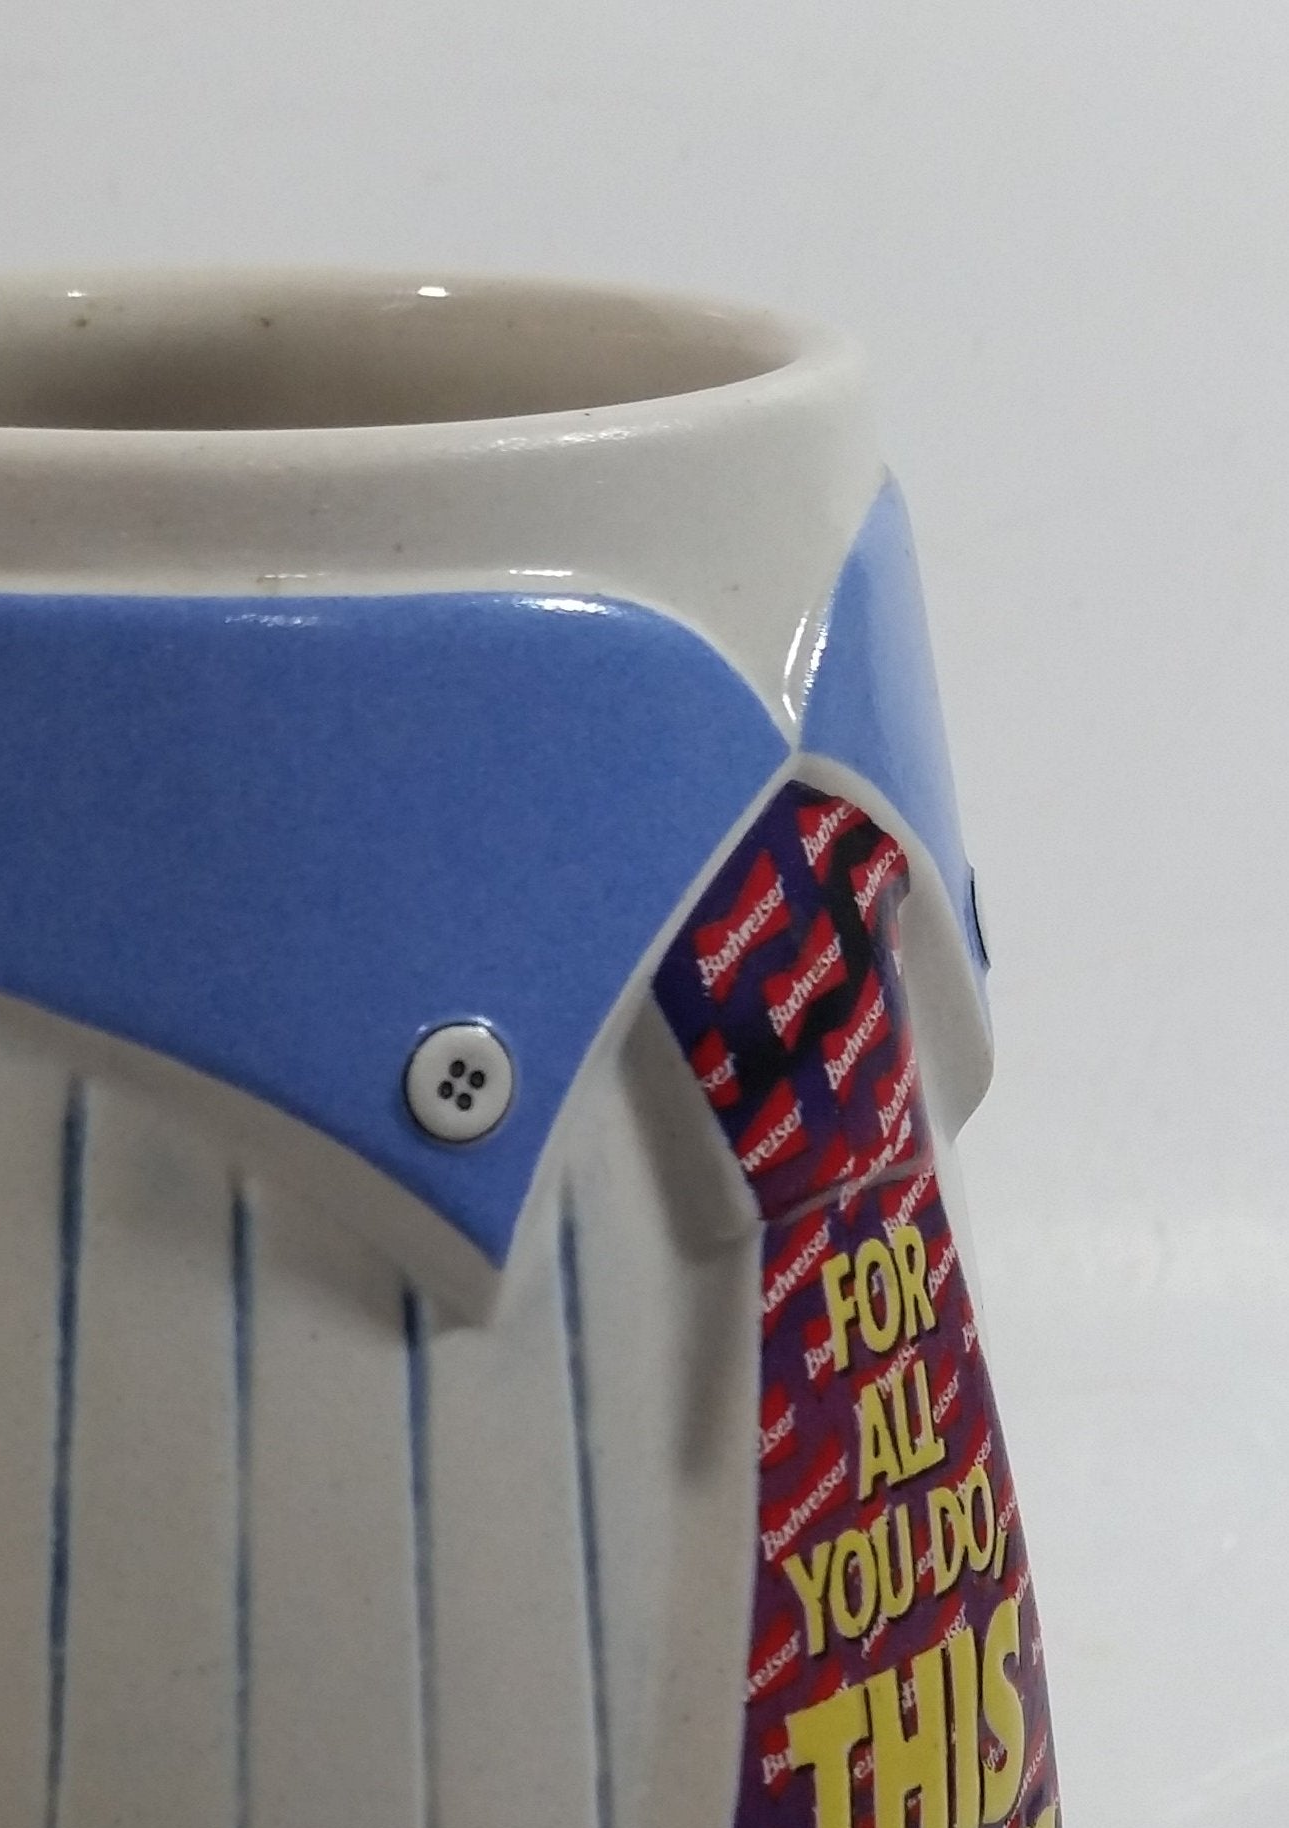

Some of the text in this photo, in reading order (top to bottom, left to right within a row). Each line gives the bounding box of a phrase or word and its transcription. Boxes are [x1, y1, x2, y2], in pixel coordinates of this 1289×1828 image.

[822, 1225, 937, 1373] FOR
[857, 1360, 946, 1500] ALL
[781, 1465, 1007, 1656] YOU DO,
